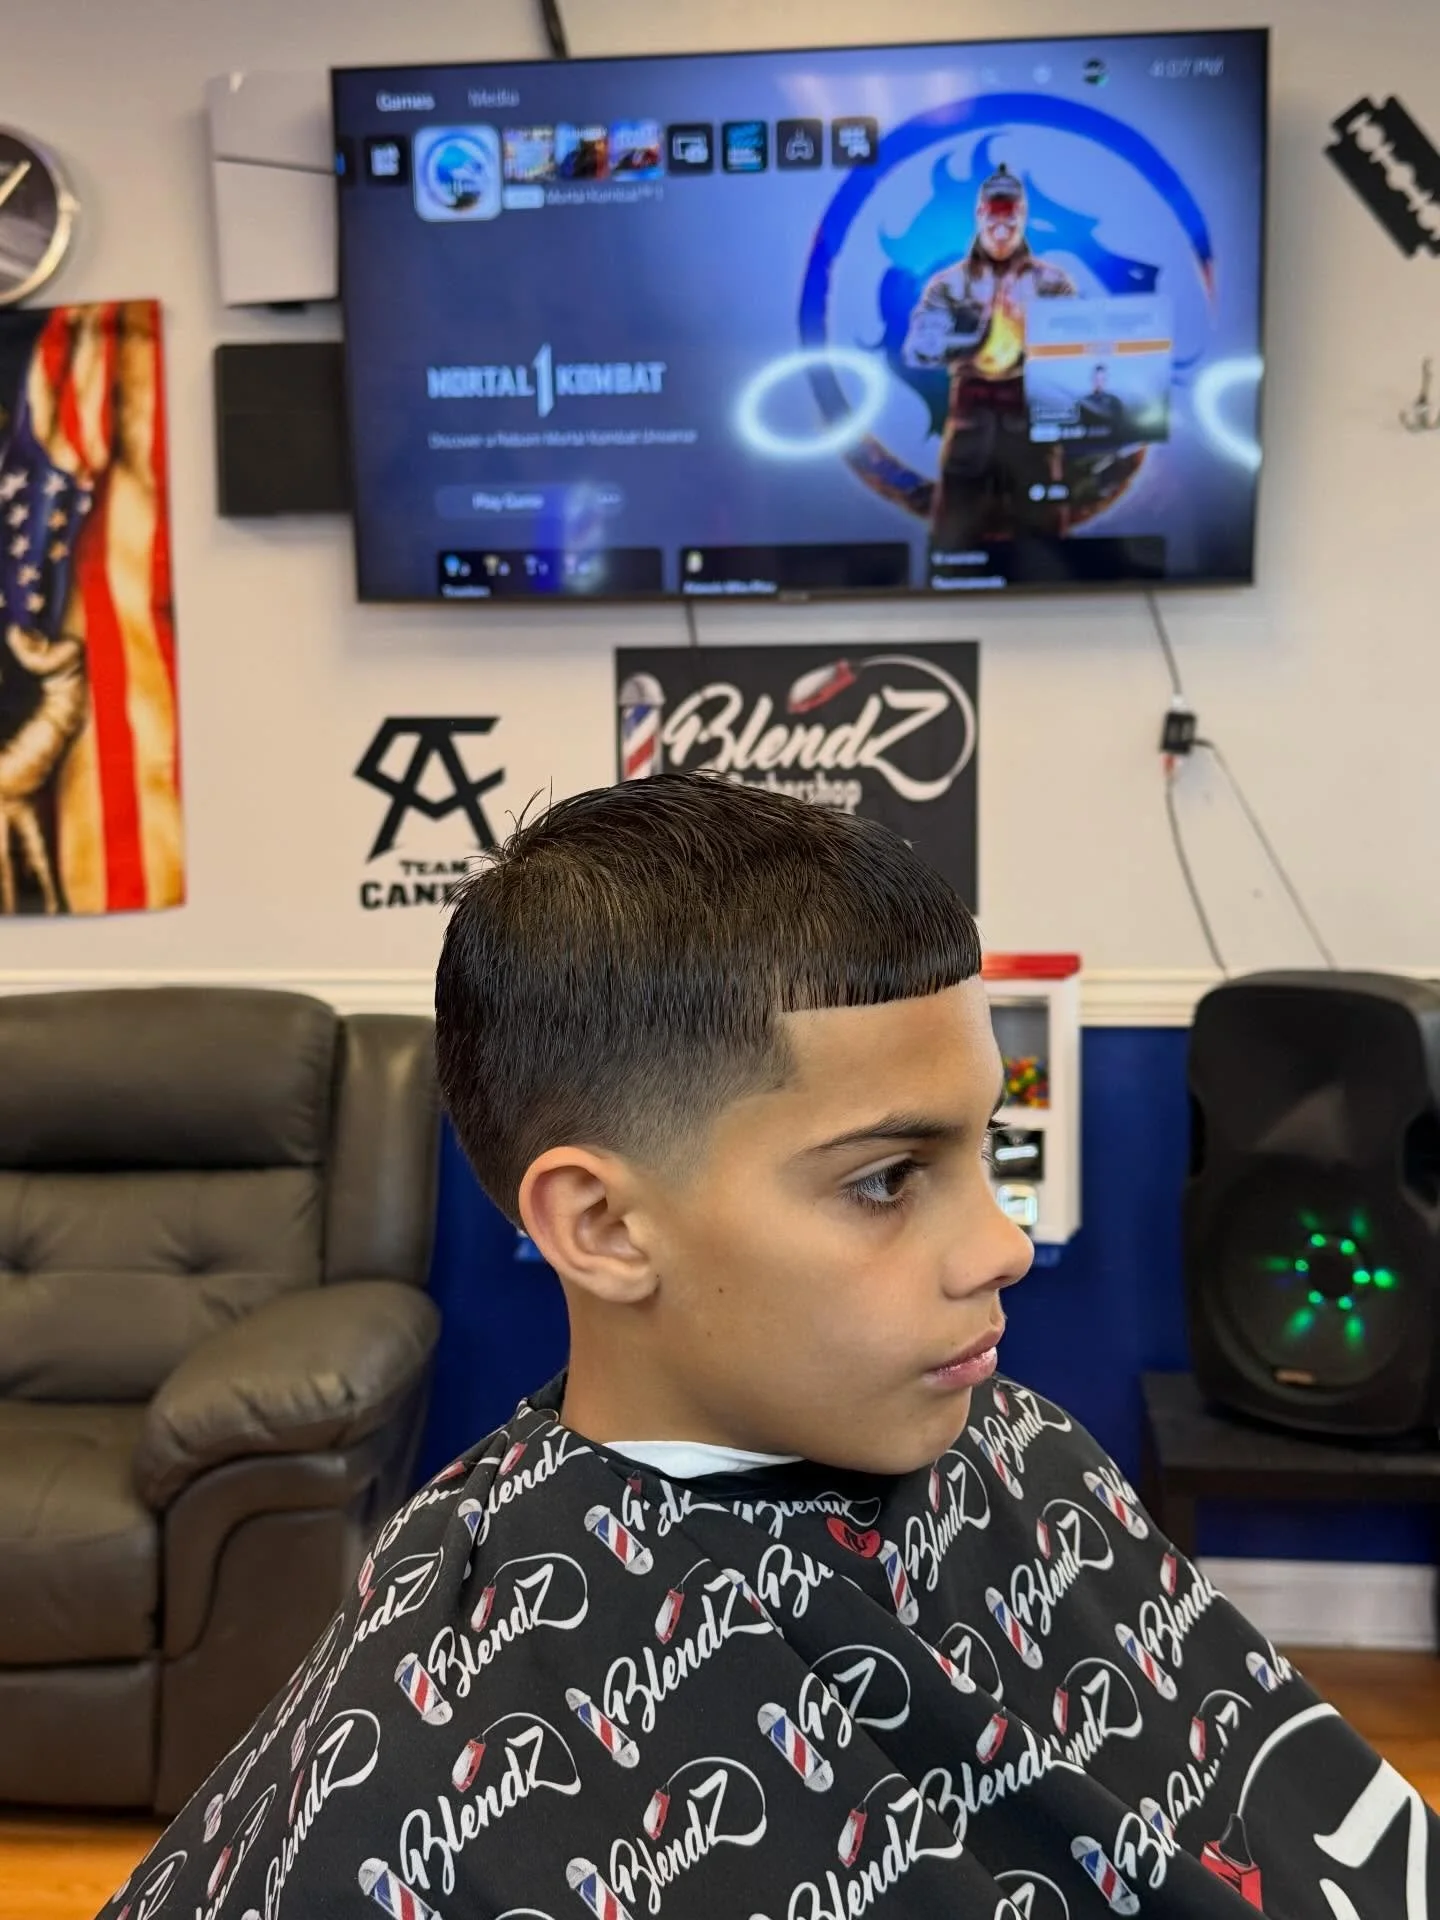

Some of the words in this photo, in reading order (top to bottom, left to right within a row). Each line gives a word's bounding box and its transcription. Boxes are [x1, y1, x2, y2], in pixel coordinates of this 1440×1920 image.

[427, 366, 535, 399] MORTAL
[556, 362, 667, 396] KOMBAT
[400, 860, 468, 875] TEAM
[477, 1425, 596, 1547] lendZ
[428, 1563, 588, 1698] BlendZ
[1010, 1509, 1115, 1637] BlendZ
[400, 1725, 581, 1896] BlendZ
[610, 1769, 767, 1915] BlendZ
